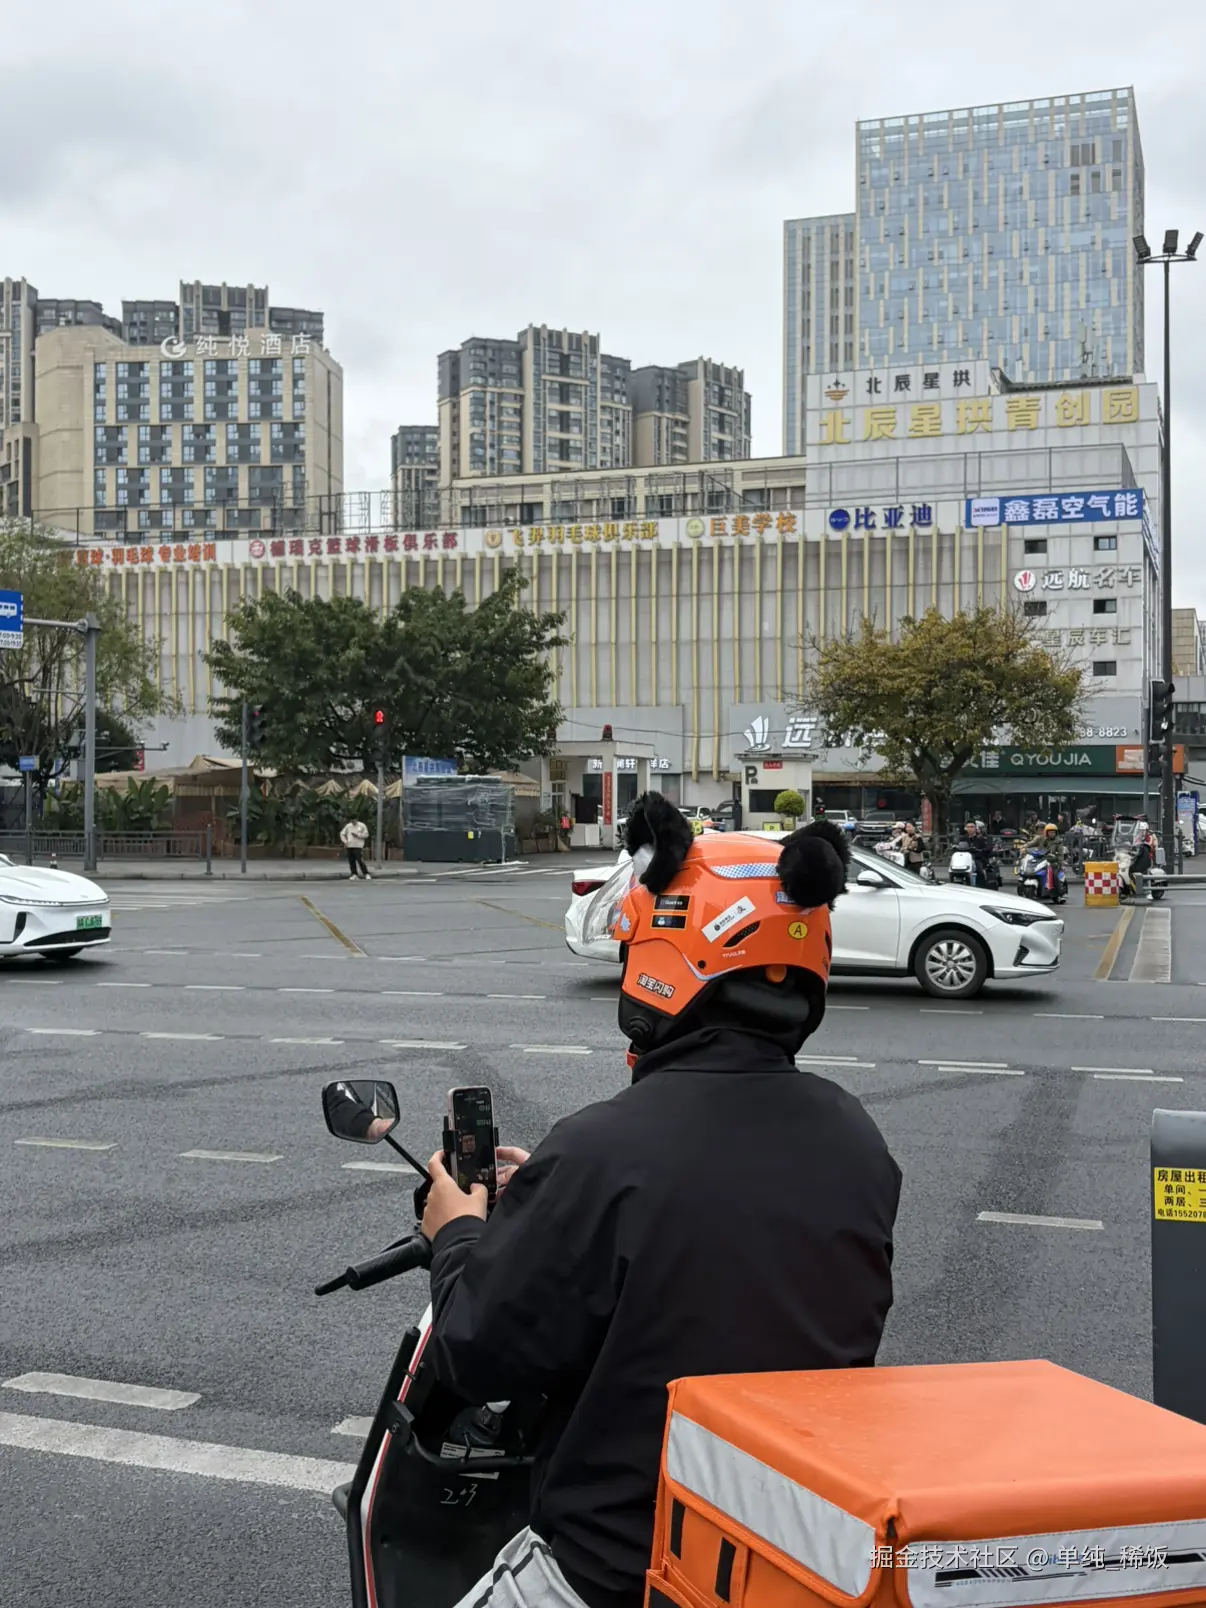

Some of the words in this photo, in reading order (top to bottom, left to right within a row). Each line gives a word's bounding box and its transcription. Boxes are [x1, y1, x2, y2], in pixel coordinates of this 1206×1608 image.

[195, 332, 312, 357] 纯悦酒店
[865, 369, 972, 394] 北辰星拱
[818, 387, 1140, 445] 北辰星拱青创园
[853, 503, 933, 531] 比亚迪
[1004, 492, 1139, 522] 鑫磊空气能
[709, 511, 798, 537] 巨美学校
[1041, 567, 1141, 590] 远航名车
[1010, 752, 1092, 767] QYOUJIA
[637, 973, 675, 999] 淘宝闪购
[1157, 1170, 1206, 1183] 房屋出租
